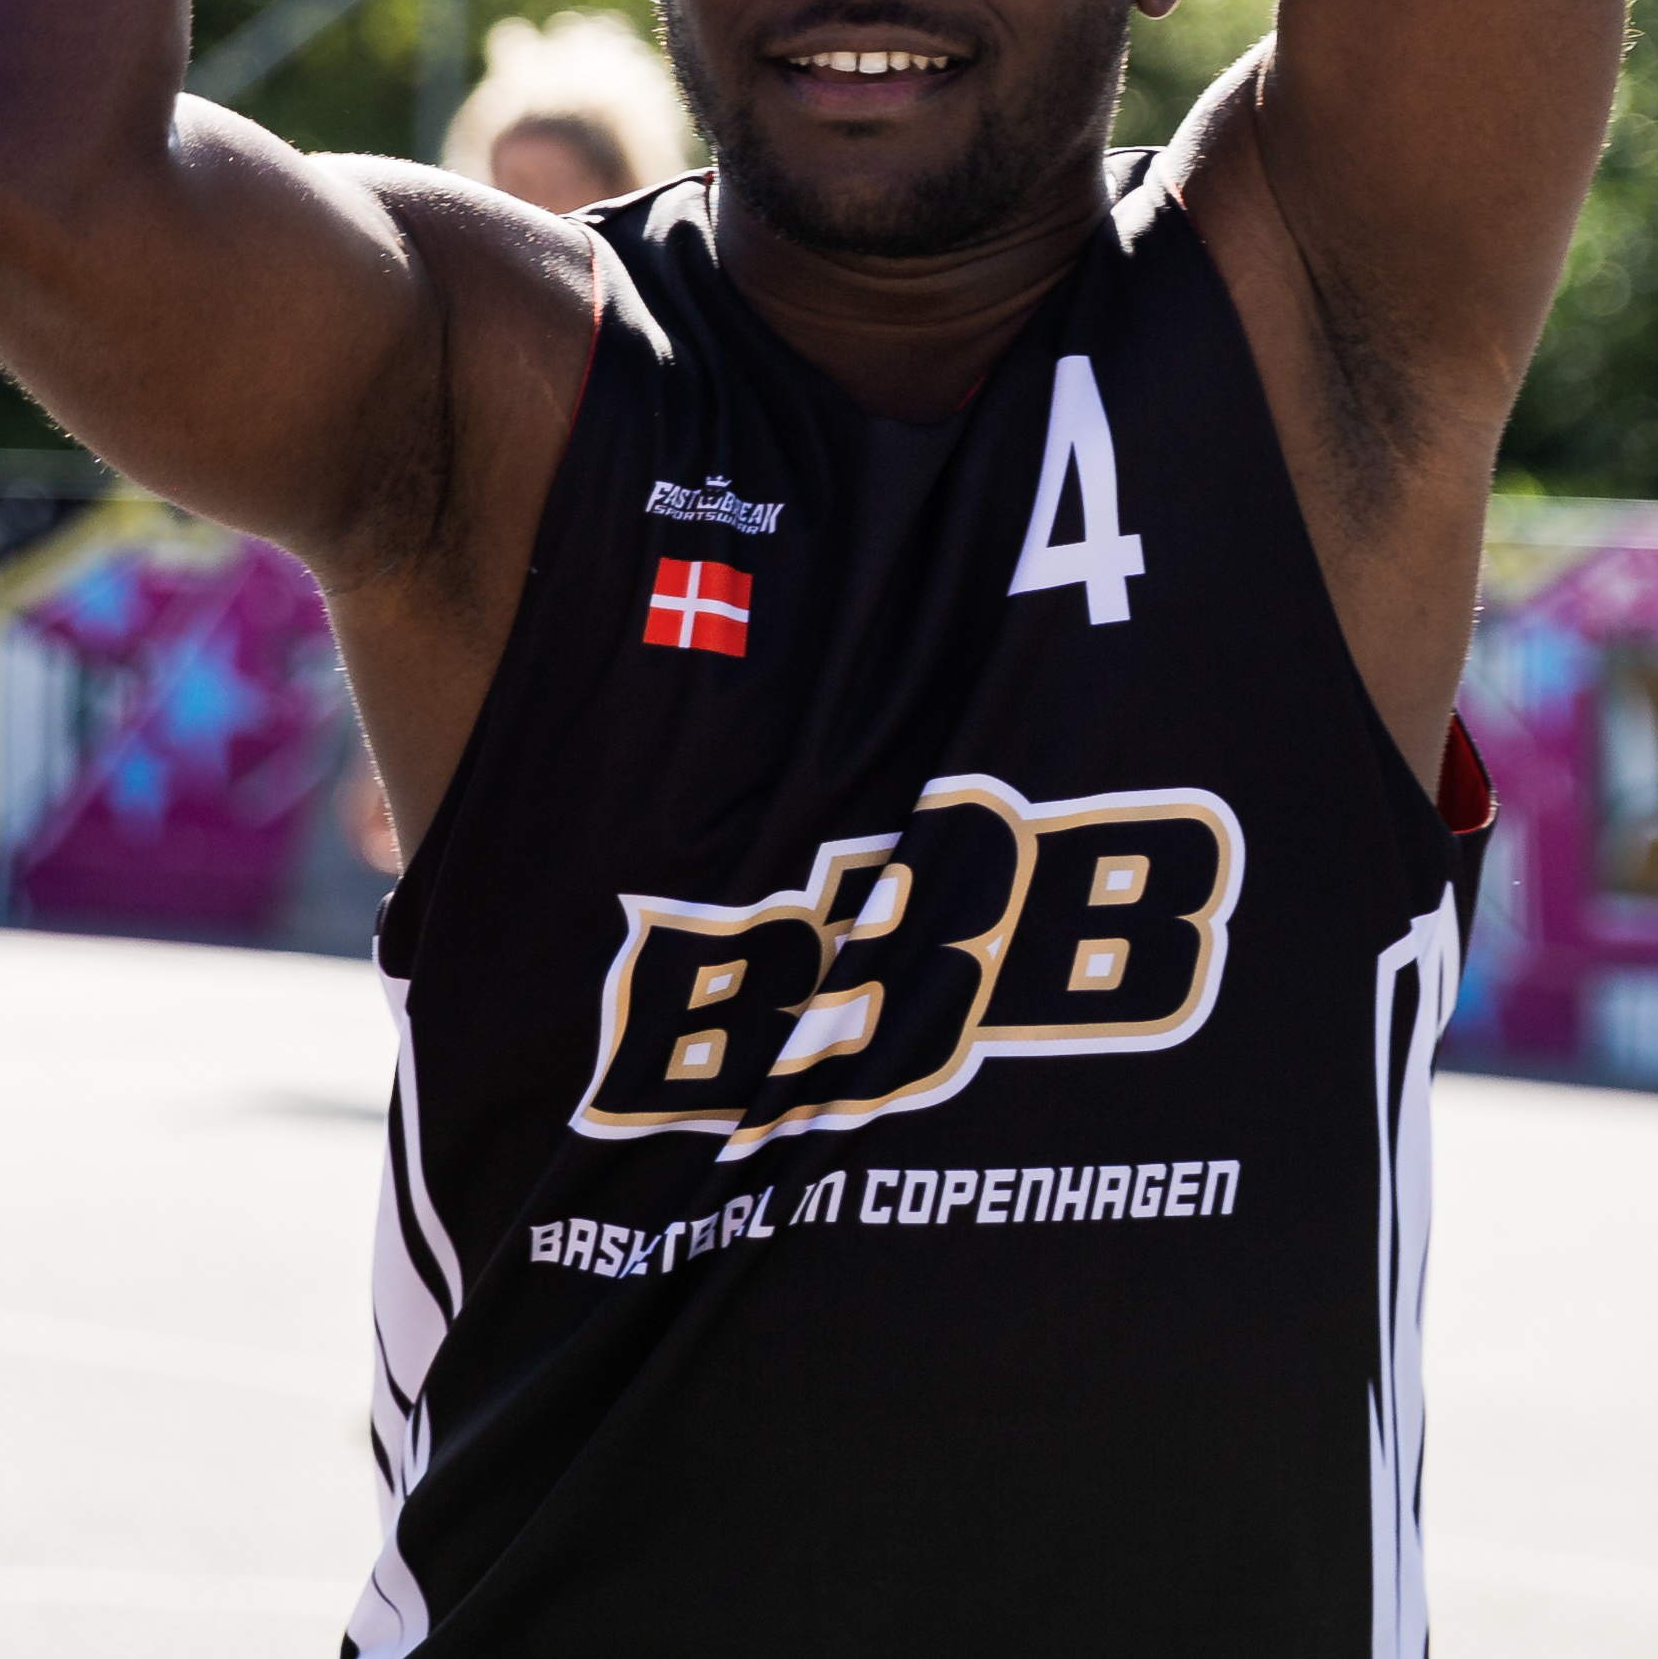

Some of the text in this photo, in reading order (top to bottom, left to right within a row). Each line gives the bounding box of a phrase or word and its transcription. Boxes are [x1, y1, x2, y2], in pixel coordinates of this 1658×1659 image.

[645, 480, 786, 535] FAST BREAK
[1007, 354, 1145, 626] 4
[566, 773, 1246, 1163] BBB
[788, 1170, 847, 1226] IN
[859, 1160, 1240, 1225] COPENHAGEN
